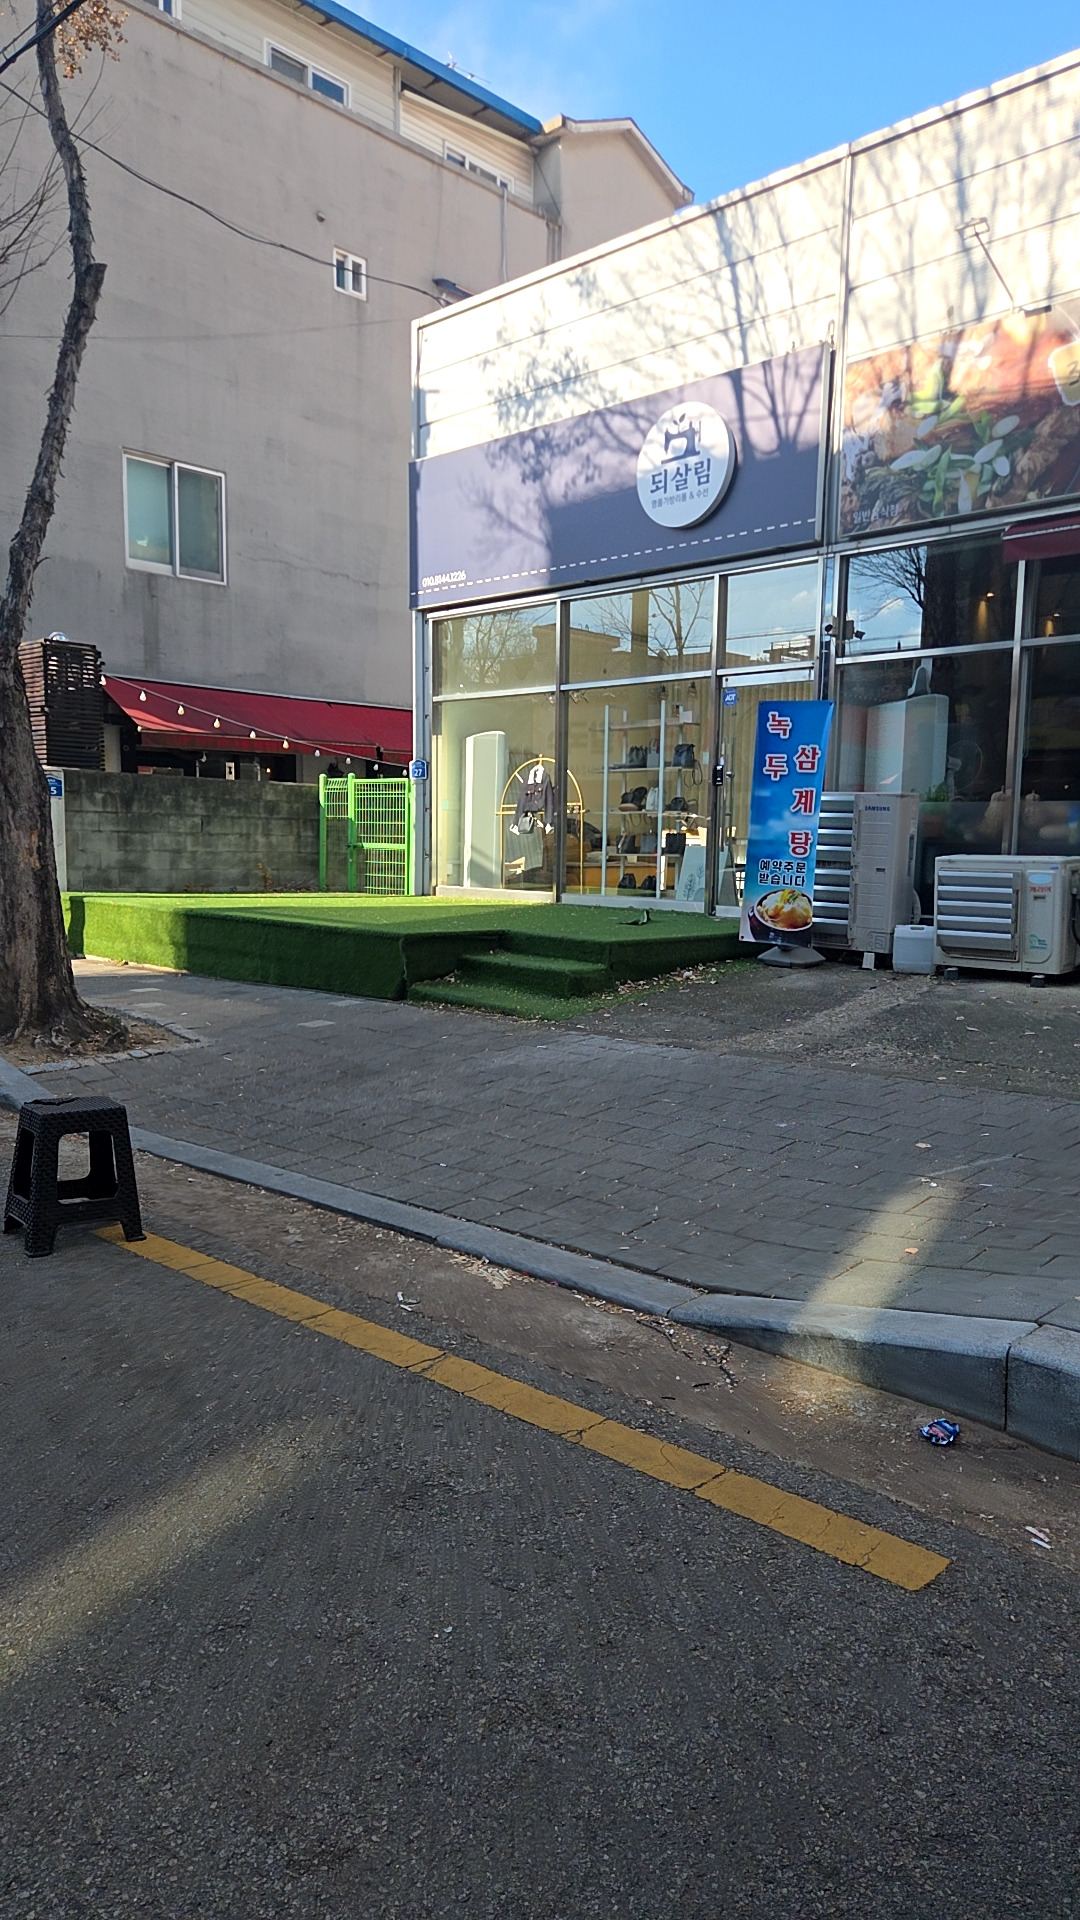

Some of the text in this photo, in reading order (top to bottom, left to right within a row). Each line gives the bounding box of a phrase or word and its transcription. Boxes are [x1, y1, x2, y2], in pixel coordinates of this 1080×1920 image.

[650, 457, 711, 494] 되살림
[689, 491, 694, 500] &
[763, 711, 792, 781] 녹두
[413, 768, 423, 777] 27
[789, 745, 821, 858] 삼계탕
[759, 859, 807, 874] 예약주문
[758, 872, 806, 888] 받습니다
